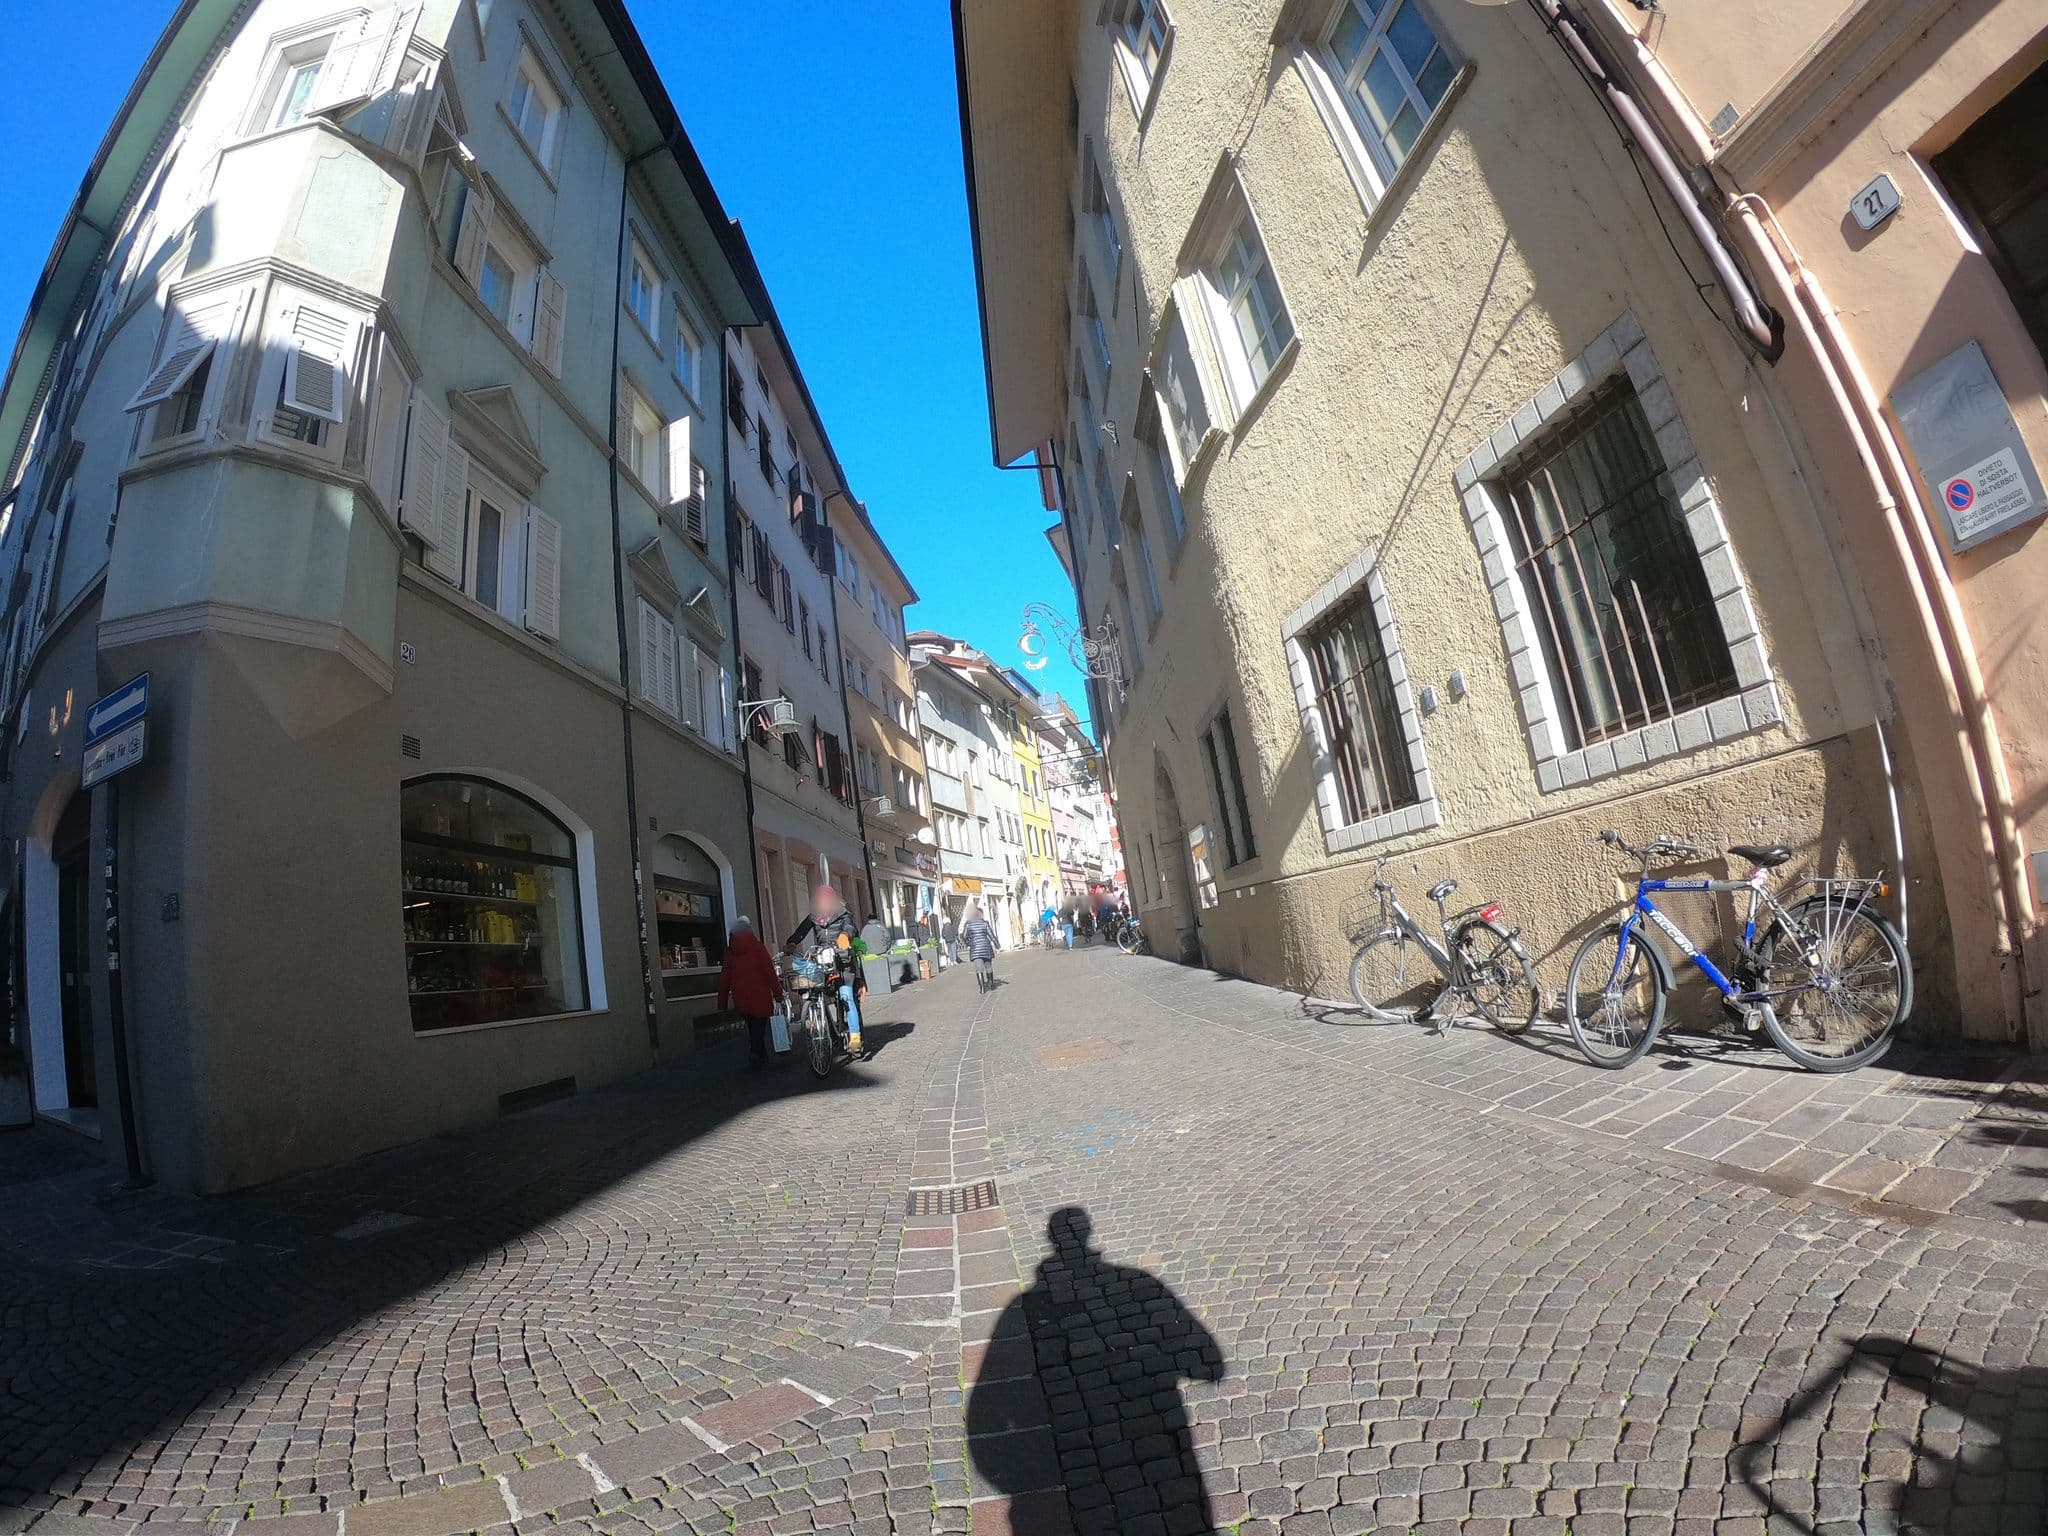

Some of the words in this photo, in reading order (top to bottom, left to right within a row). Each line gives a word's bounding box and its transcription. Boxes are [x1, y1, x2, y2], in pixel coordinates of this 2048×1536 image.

[1863, 189, 1884, 215] 27
[1978, 459, 2003, 477] DIVIETO
[1979, 479, 1987, 487] DI
[1987, 467, 2009, 484] SOSTA
[1976, 472, 2018, 499] HALTVERBOT
[1956, 510, 1979, 526] LASCIARE
[1979, 502, 1995, 516] LIBERO
[1998, 488, 2024, 504] PASSAGGIO
[1997, 496, 2028, 514] FREILASSEN
